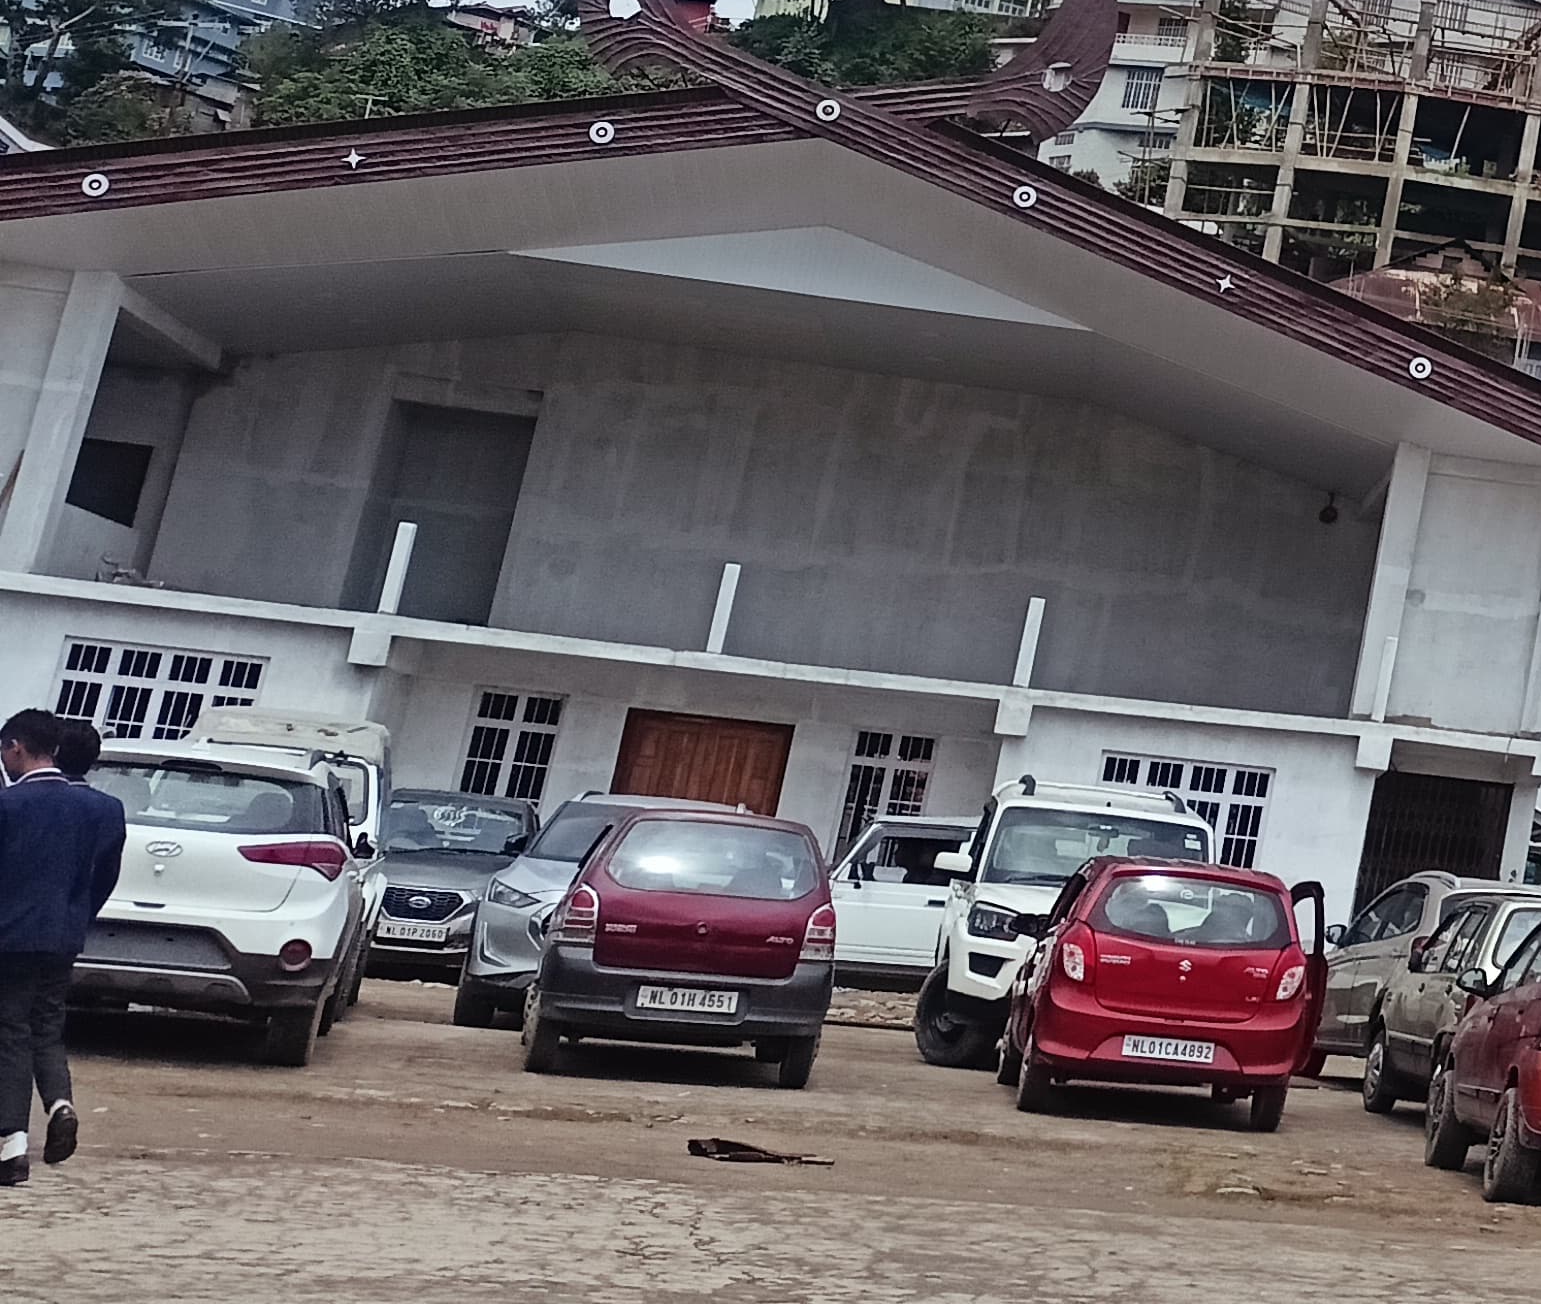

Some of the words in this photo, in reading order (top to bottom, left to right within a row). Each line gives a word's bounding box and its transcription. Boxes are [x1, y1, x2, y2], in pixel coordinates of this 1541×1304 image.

[649, 990, 665, 1005] NL
[670, 992, 695, 1007] 01H
[700, 994, 733, 1011] 4551
[1131, 1039, 1212, 1060] NL01CA4892
